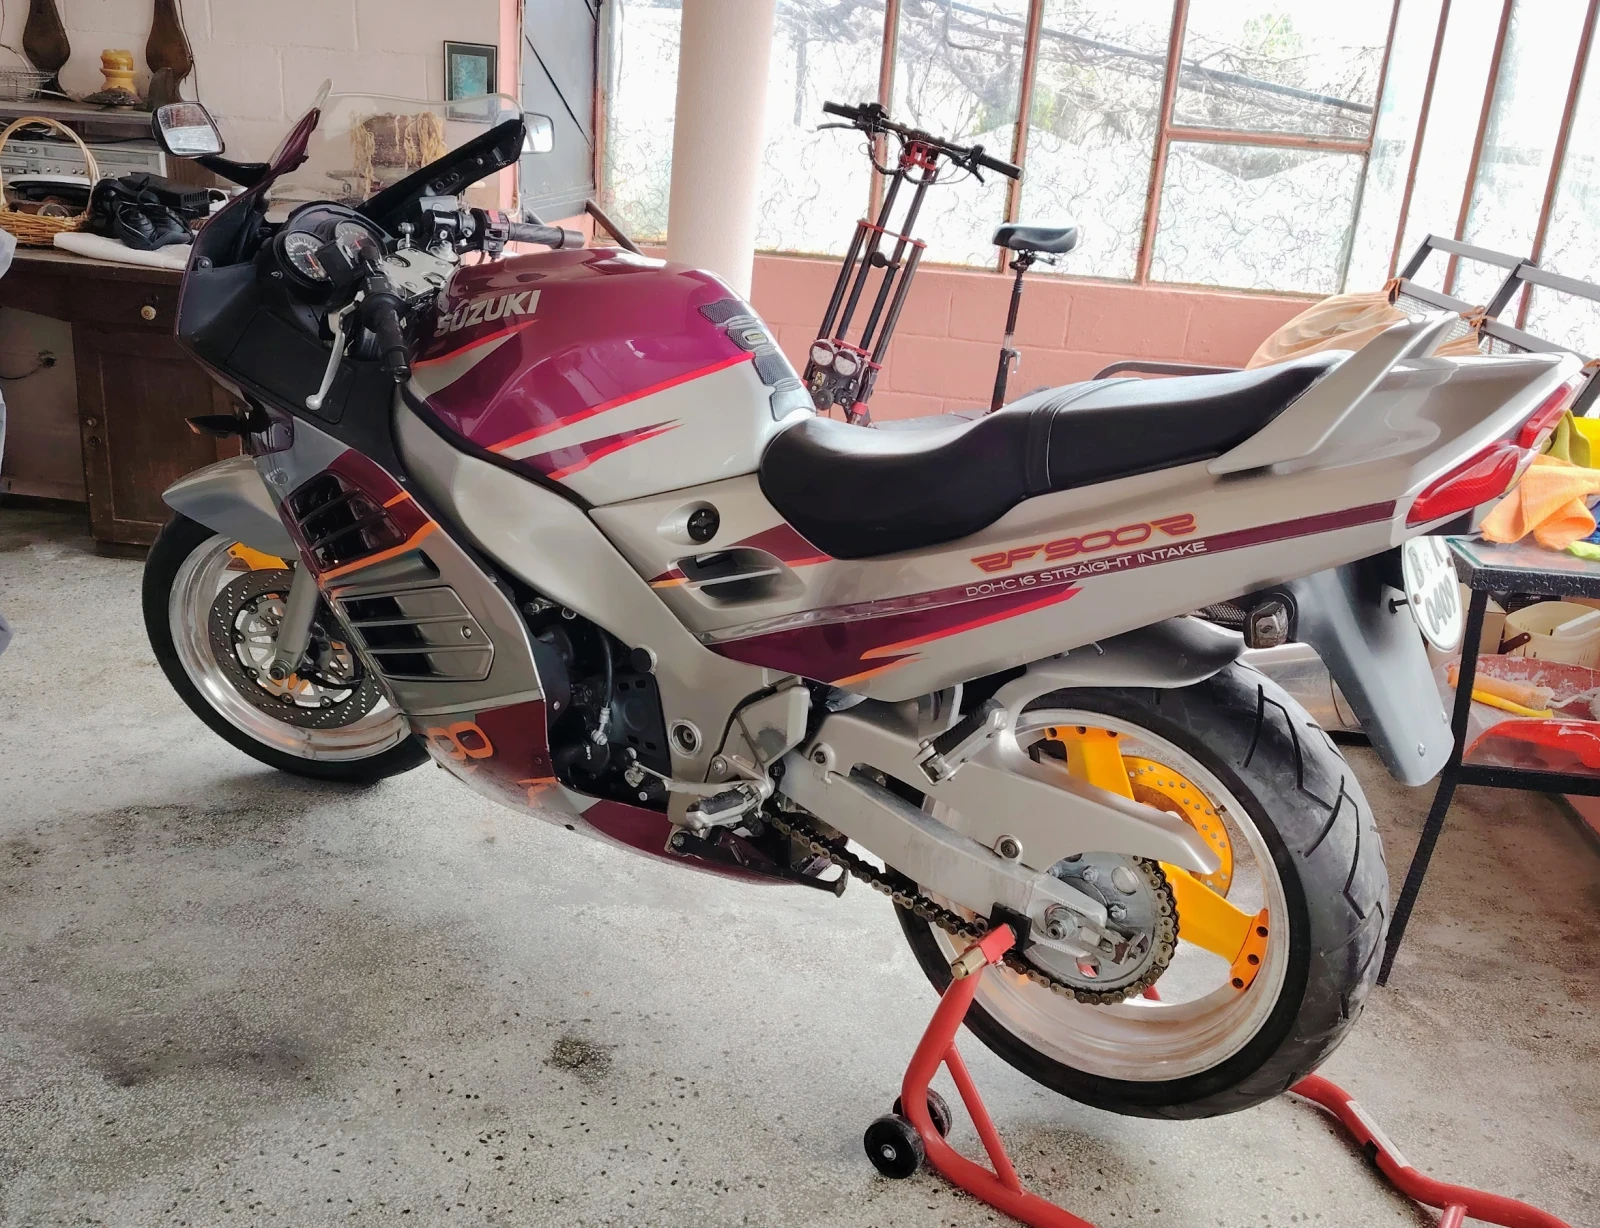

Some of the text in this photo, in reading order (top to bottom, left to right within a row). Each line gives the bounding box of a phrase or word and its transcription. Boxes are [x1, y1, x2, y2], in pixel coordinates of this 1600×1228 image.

[434, 290, 542, 337] SUZUKI
[965, 541, 1207, 597] DOHC 16 STRAIGHT INTAKE
[1408, 546, 1425, 589] B
